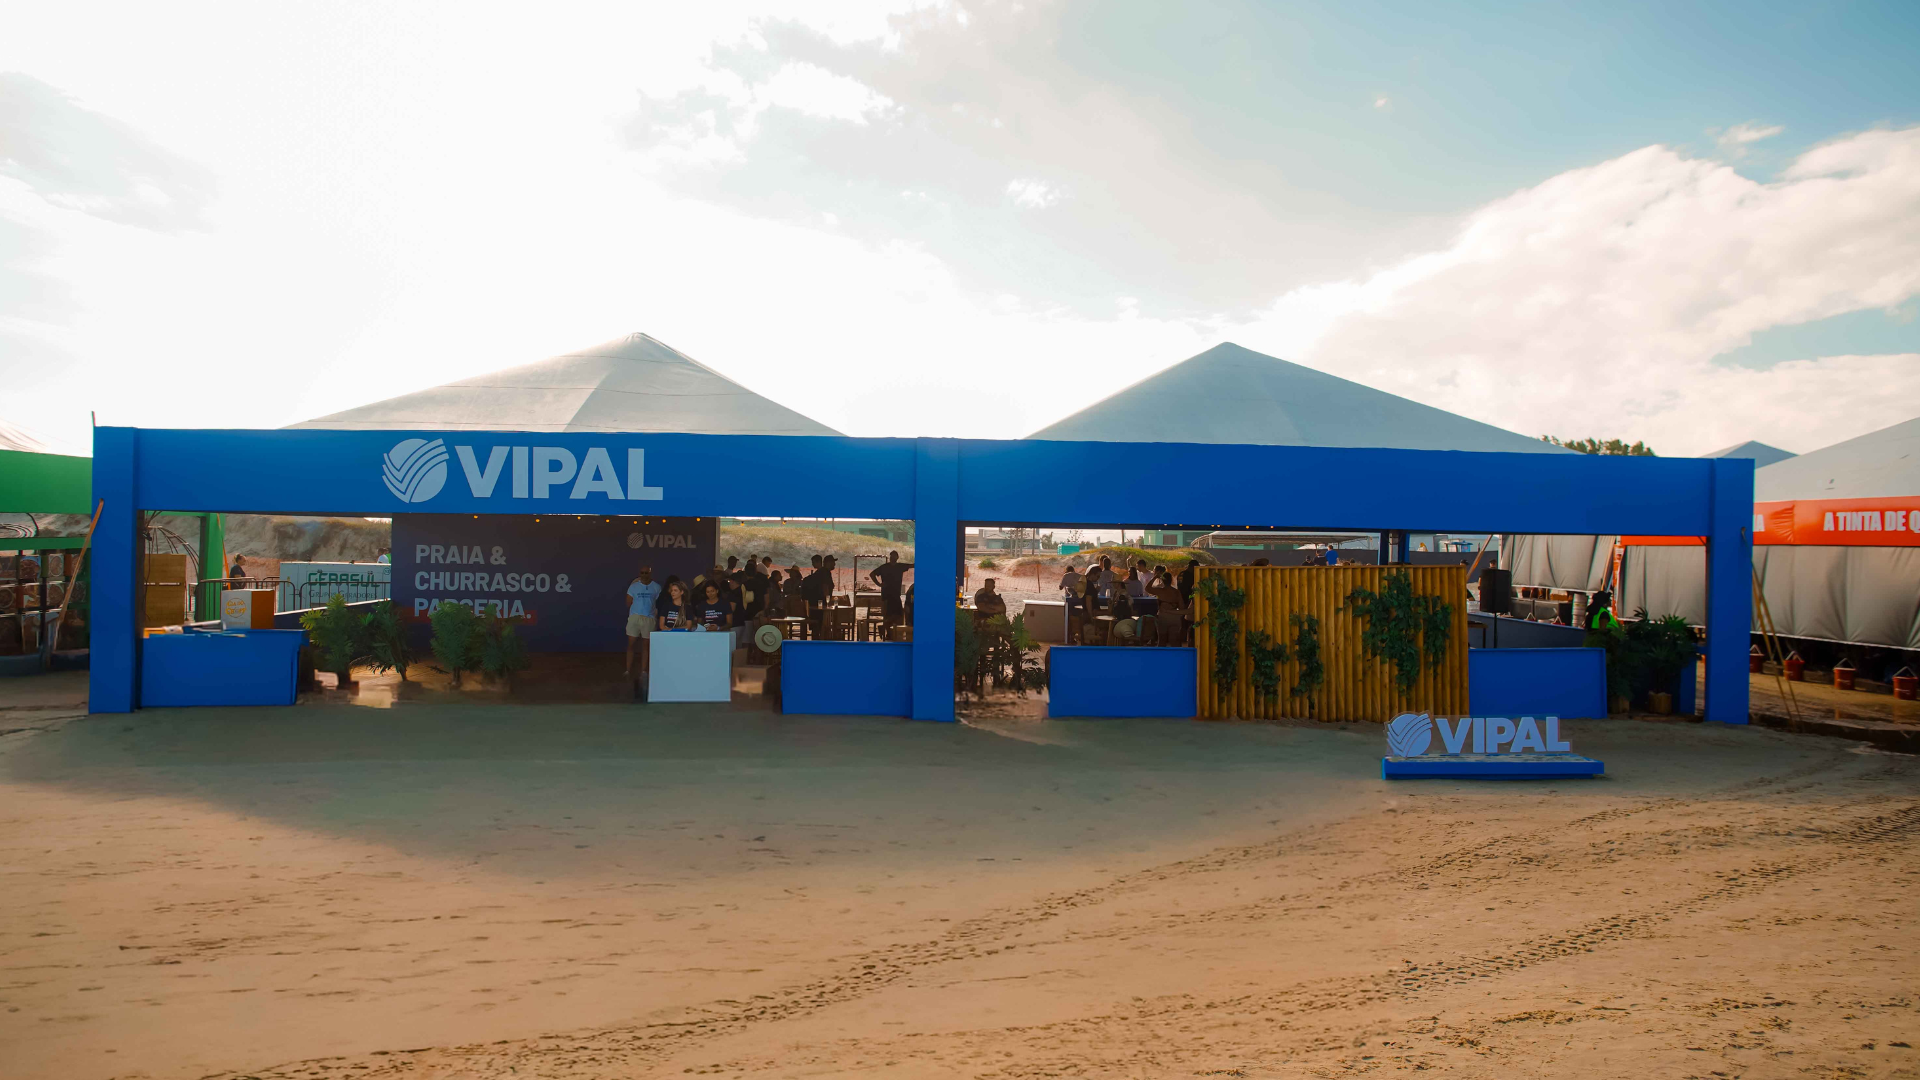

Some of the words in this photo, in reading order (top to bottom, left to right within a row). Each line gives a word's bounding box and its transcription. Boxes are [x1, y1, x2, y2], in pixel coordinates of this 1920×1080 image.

[454, 445, 664, 501] VIPAL
[1823, 512, 1835, 532] A
[1836, 511, 1882, 532] TINTA
[1884, 510, 1907, 532] DE
[645, 534, 697, 549] VIPAL
[415, 544, 485, 565] PRAIA
[489, 546, 507, 566] &
[414, 571, 550, 593] CHURRASCO
[555, 573, 572, 593] &
[414, 597, 532, 620] PAERIA.
[1435, 716, 1571, 753] VIPAL
